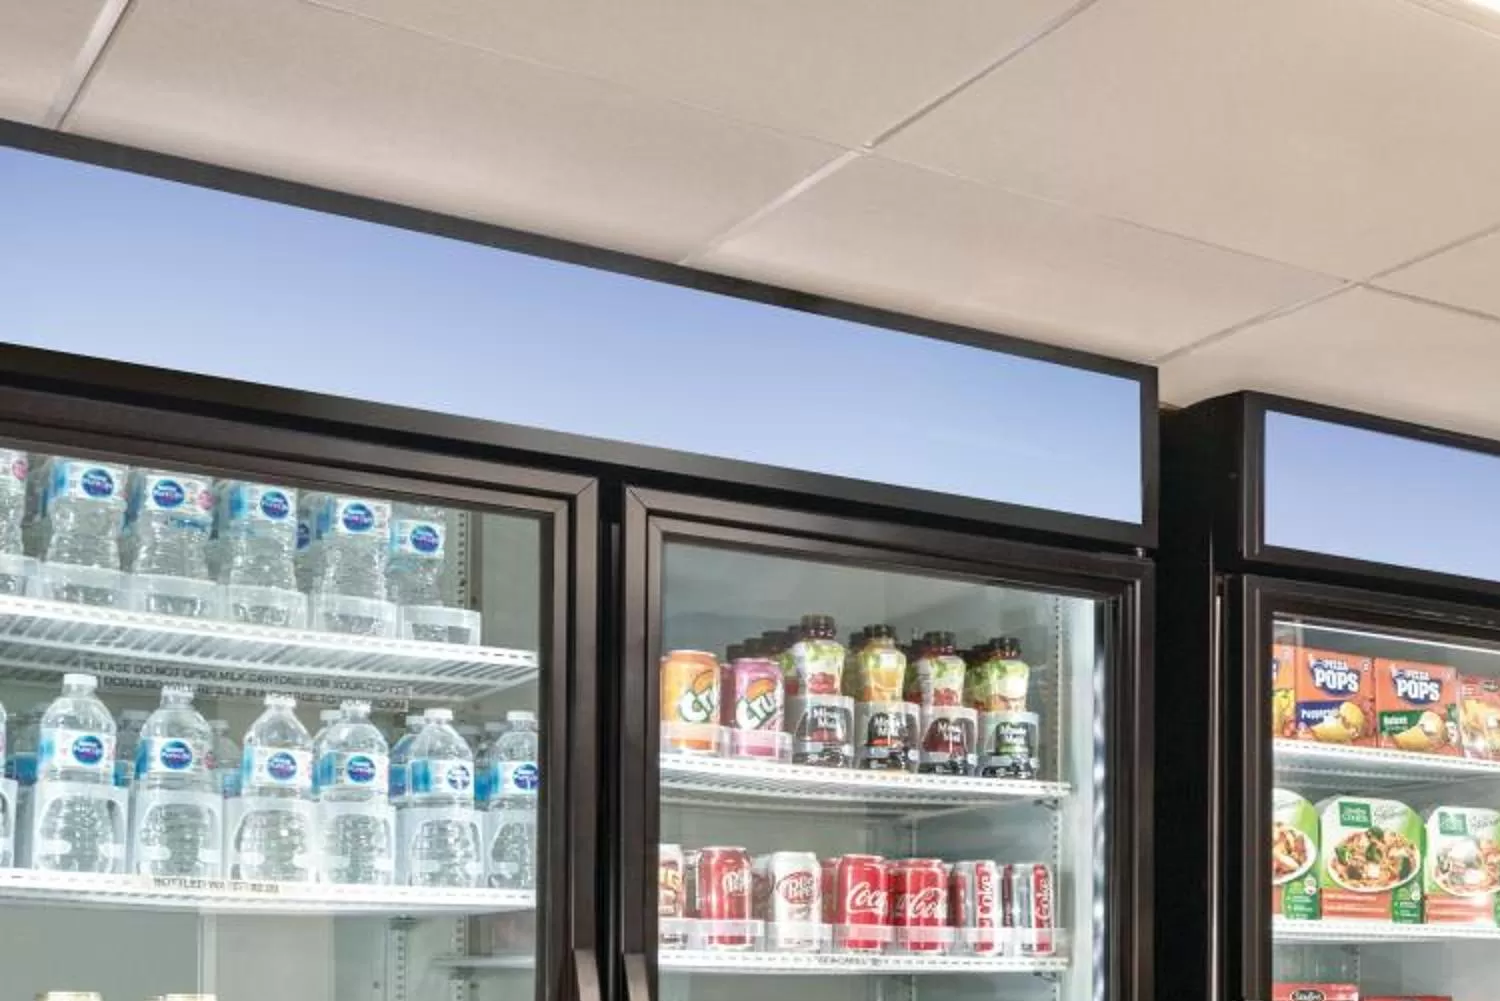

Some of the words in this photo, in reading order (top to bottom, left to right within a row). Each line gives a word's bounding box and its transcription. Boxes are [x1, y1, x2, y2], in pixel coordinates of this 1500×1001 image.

[1314, 668, 1359, 693] POPS
[1396, 679, 1442, 700] POPS
[736, 690, 784, 729] Cru
